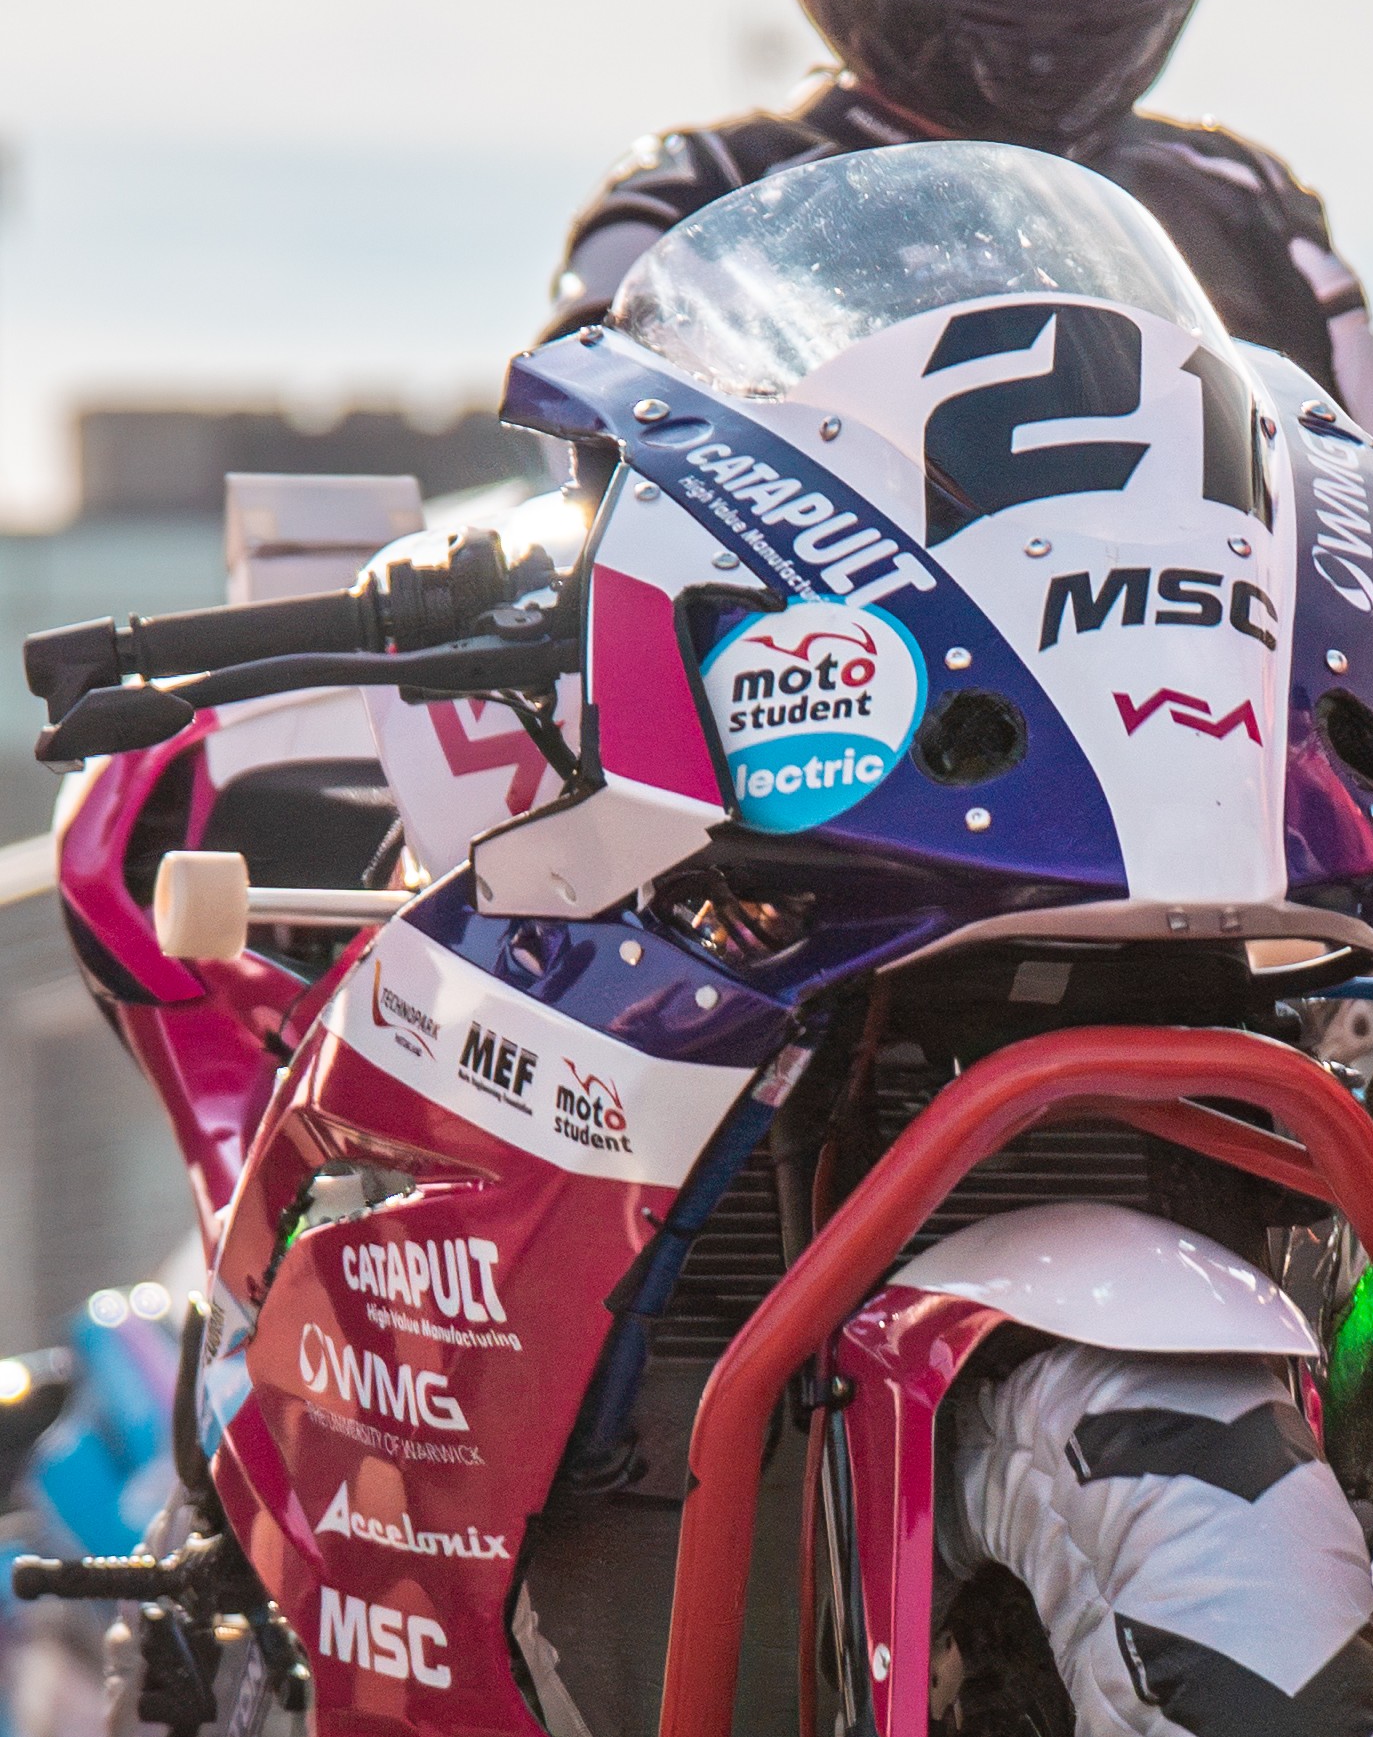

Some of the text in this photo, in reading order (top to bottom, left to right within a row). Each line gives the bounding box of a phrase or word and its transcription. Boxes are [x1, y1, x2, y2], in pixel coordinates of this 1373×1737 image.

[922, 302, 1274, 548] 21
[686, 440, 937, 608] CATAPULT
[709, 498, 747, 534] Value
[1301, 428, 1373, 559] WMG
[1039, 567, 1278, 653] MSC
[729, 691, 872, 733] student
[732, 652, 876, 703] moto
[735, 748, 885, 801] lectric
[460, 1020, 539, 1097] MEF
[555, 1115, 633, 1153] student
[556, 1085, 627, 1132] moto
[342, 1236, 508, 1324] CATAPULT
[366, 1302, 523, 1352] High Value Manufacturing
[325, 1335, 471, 1432] WMG
[314, 1479, 511, 1561] Accelonix
[319, 1585, 452, 1690] MSC
